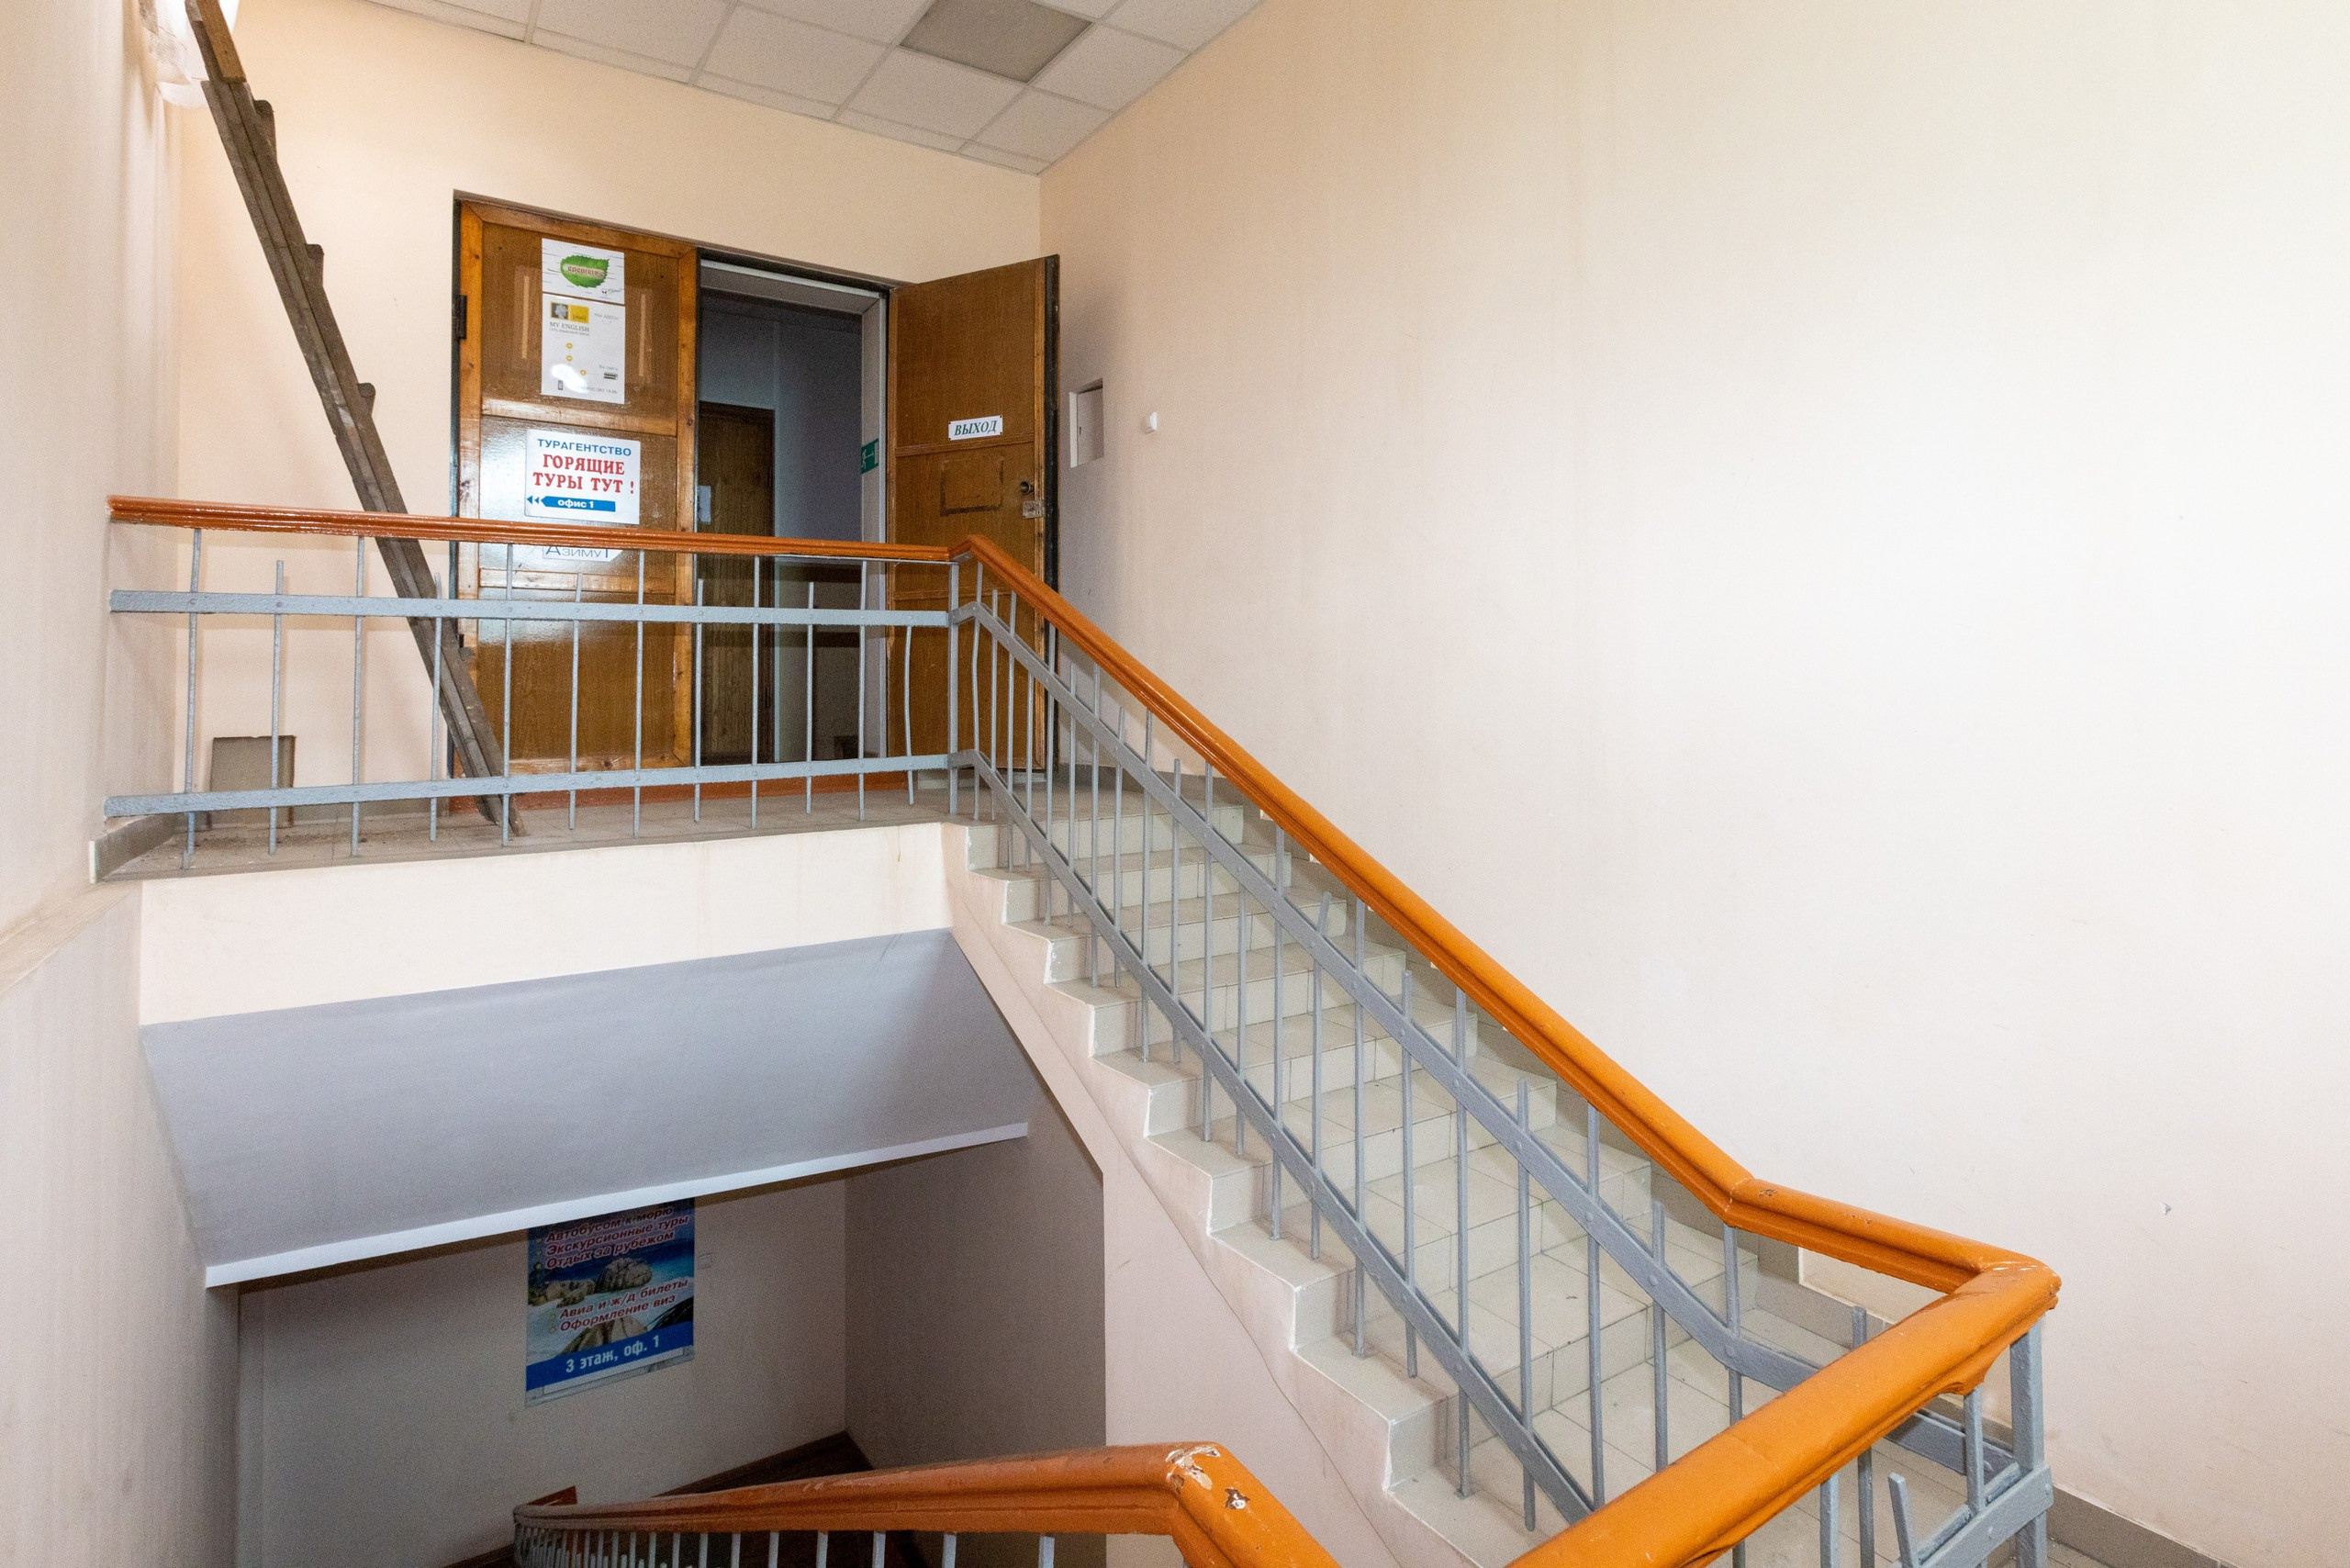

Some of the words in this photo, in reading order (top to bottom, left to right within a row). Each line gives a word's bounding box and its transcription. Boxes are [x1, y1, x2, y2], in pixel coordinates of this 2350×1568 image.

[562, 323, 589, 332] ENGLISH
[955, 420, 998, 436] ВЫХОД
[537, 439, 632, 456] ТУРАГЕНТСТВО
[543, 454, 625, 475] ГОРЯЩИЕ
[532, 472, 583, 489] ТУРЫ
[590, 477, 623, 493] ТУТ
[557, 498, 588, 509] офис
[588, 500, 594, 509] 1
[547, 1220, 621, 1241] Автобусом
[637, 1208, 673, 1222] морю
[547, 1224, 653, 1255] Экскурсионные
[657, 1215, 688, 1231] туры
[547, 1251, 591, 1268] Отдых
[597, 1248, 611, 1256] за
[614, 1231, 674, 1255] рубежом
[560, 1305, 593, 1318] Авиа
[598, 1301, 606, 1310] и
[610, 1293, 635, 1306] ж/д
[640, 1279, 688, 1298] билеты
[560, 1302, 649, 1331] Оформление
[653, 1294, 676, 1308] виз
[565, 1359, 575, 1373] 3
[579, 1350, 619, 1370] этаж,
[623, 1339, 647, 1357] оф.
[653, 1335, 660, 1348] 1
